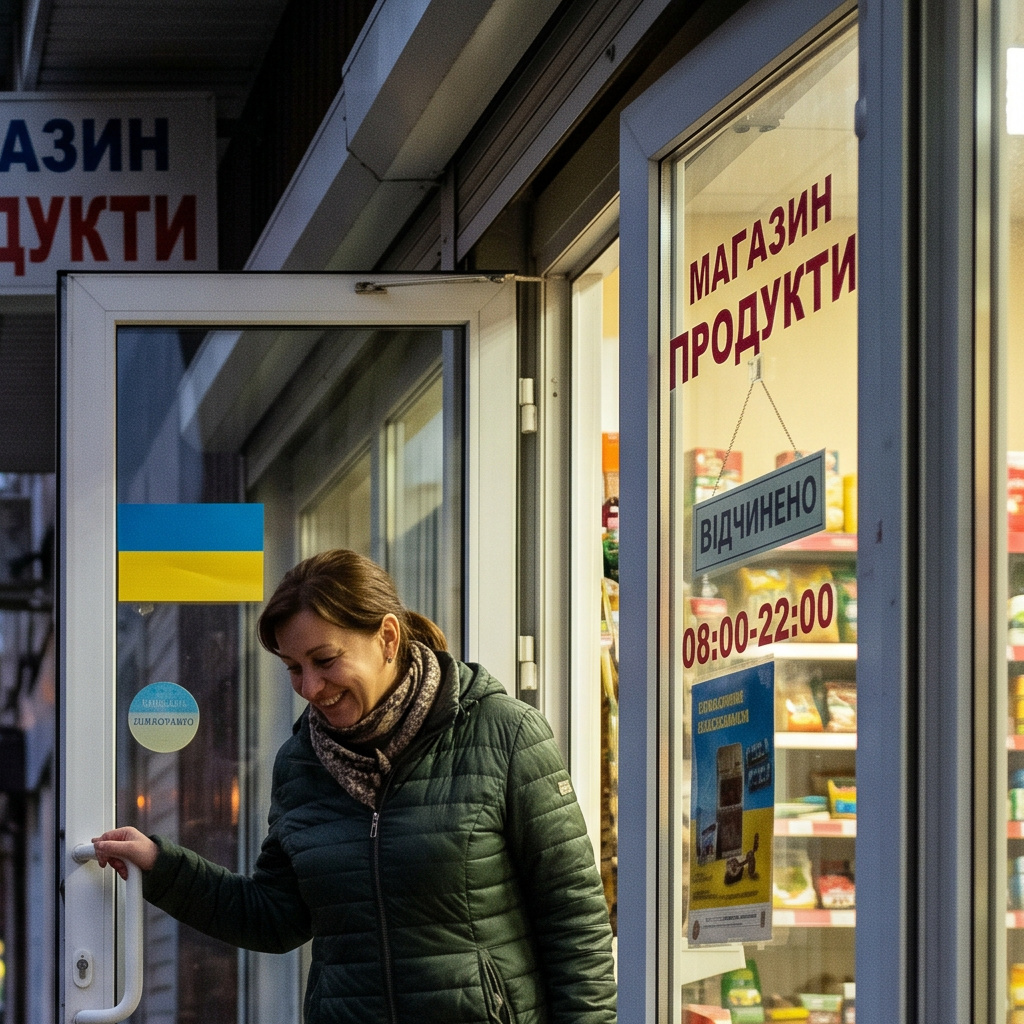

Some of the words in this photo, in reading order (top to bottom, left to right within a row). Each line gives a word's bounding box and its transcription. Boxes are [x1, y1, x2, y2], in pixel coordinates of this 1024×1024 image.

[689, 174, 832, 306] МАГАЗИН
[669, 233, 856, 391] ПРОДУКТИ
[700, 474, 817, 555] ВІДЧИНЕНО
[682, 584, 834, 669] 08:00-22:00
